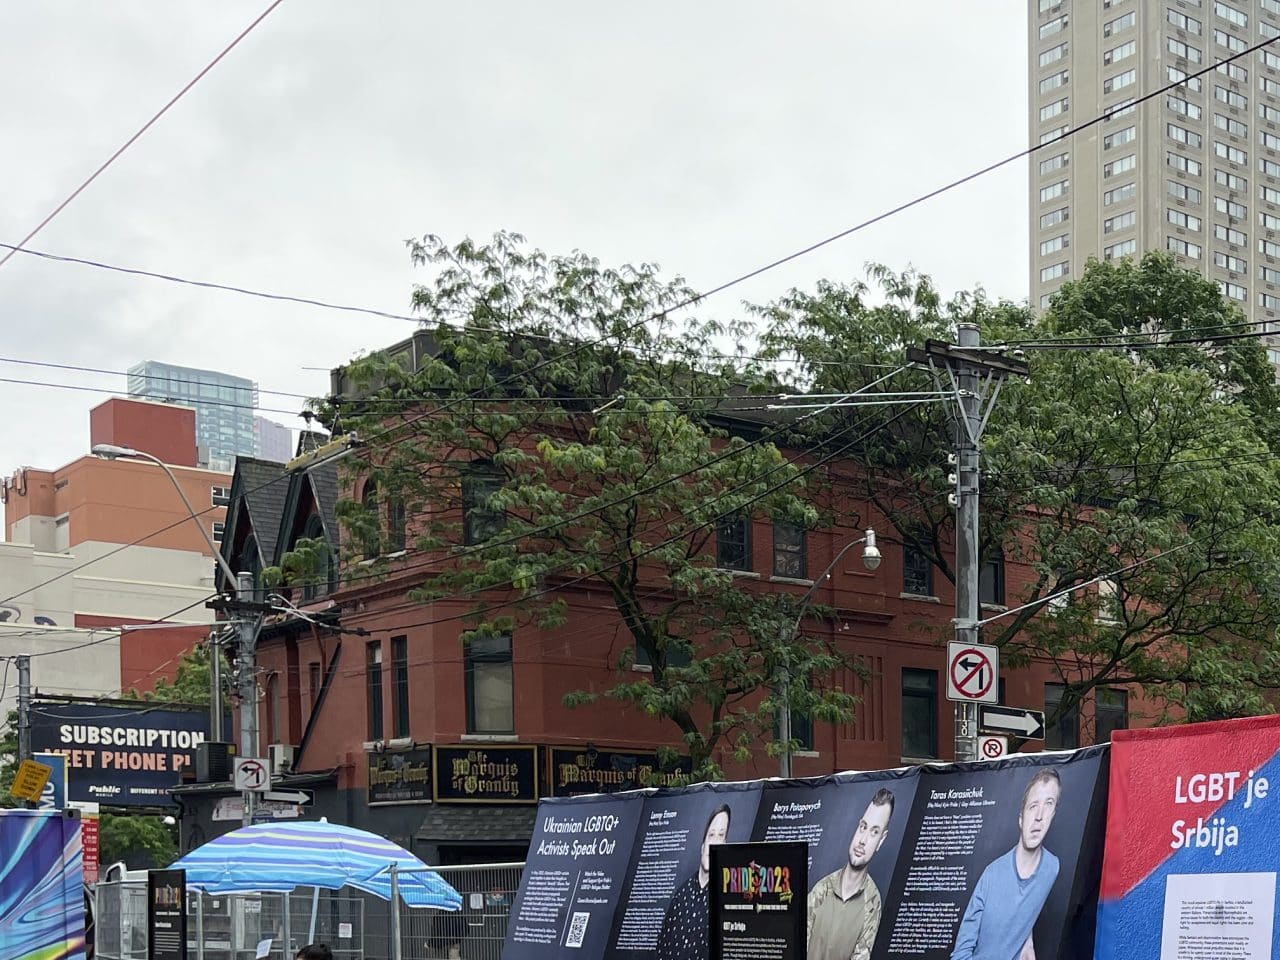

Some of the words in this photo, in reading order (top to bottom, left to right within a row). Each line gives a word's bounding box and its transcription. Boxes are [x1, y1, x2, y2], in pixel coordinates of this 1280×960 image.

[60, 724, 204, 749] SUBSCRIPTION
[46, 748, 96, 768] EET
[101, 751, 167, 771] PHONE
[452, 757, 519, 780] Marquis
[88, 785, 121, 794] Public
[464, 775, 519, 797] Granby
[930, 789, 947, 800] Taras
[1175, 772, 1240, 804] LGBT
[1244, 770, 1270, 808] je
[543, 815, 583, 834] Ukrainian
[583, 814, 620, 833] LGBTQ+
[1170, 817, 1239, 856] Srbija
[537, 839, 570, 856] Activists
[570, 840, 596, 860] Speak
[598, 838, 616, 854] Out
[722, 867, 755, 893] PRIDE
[759, 866, 790, 893] 2023
